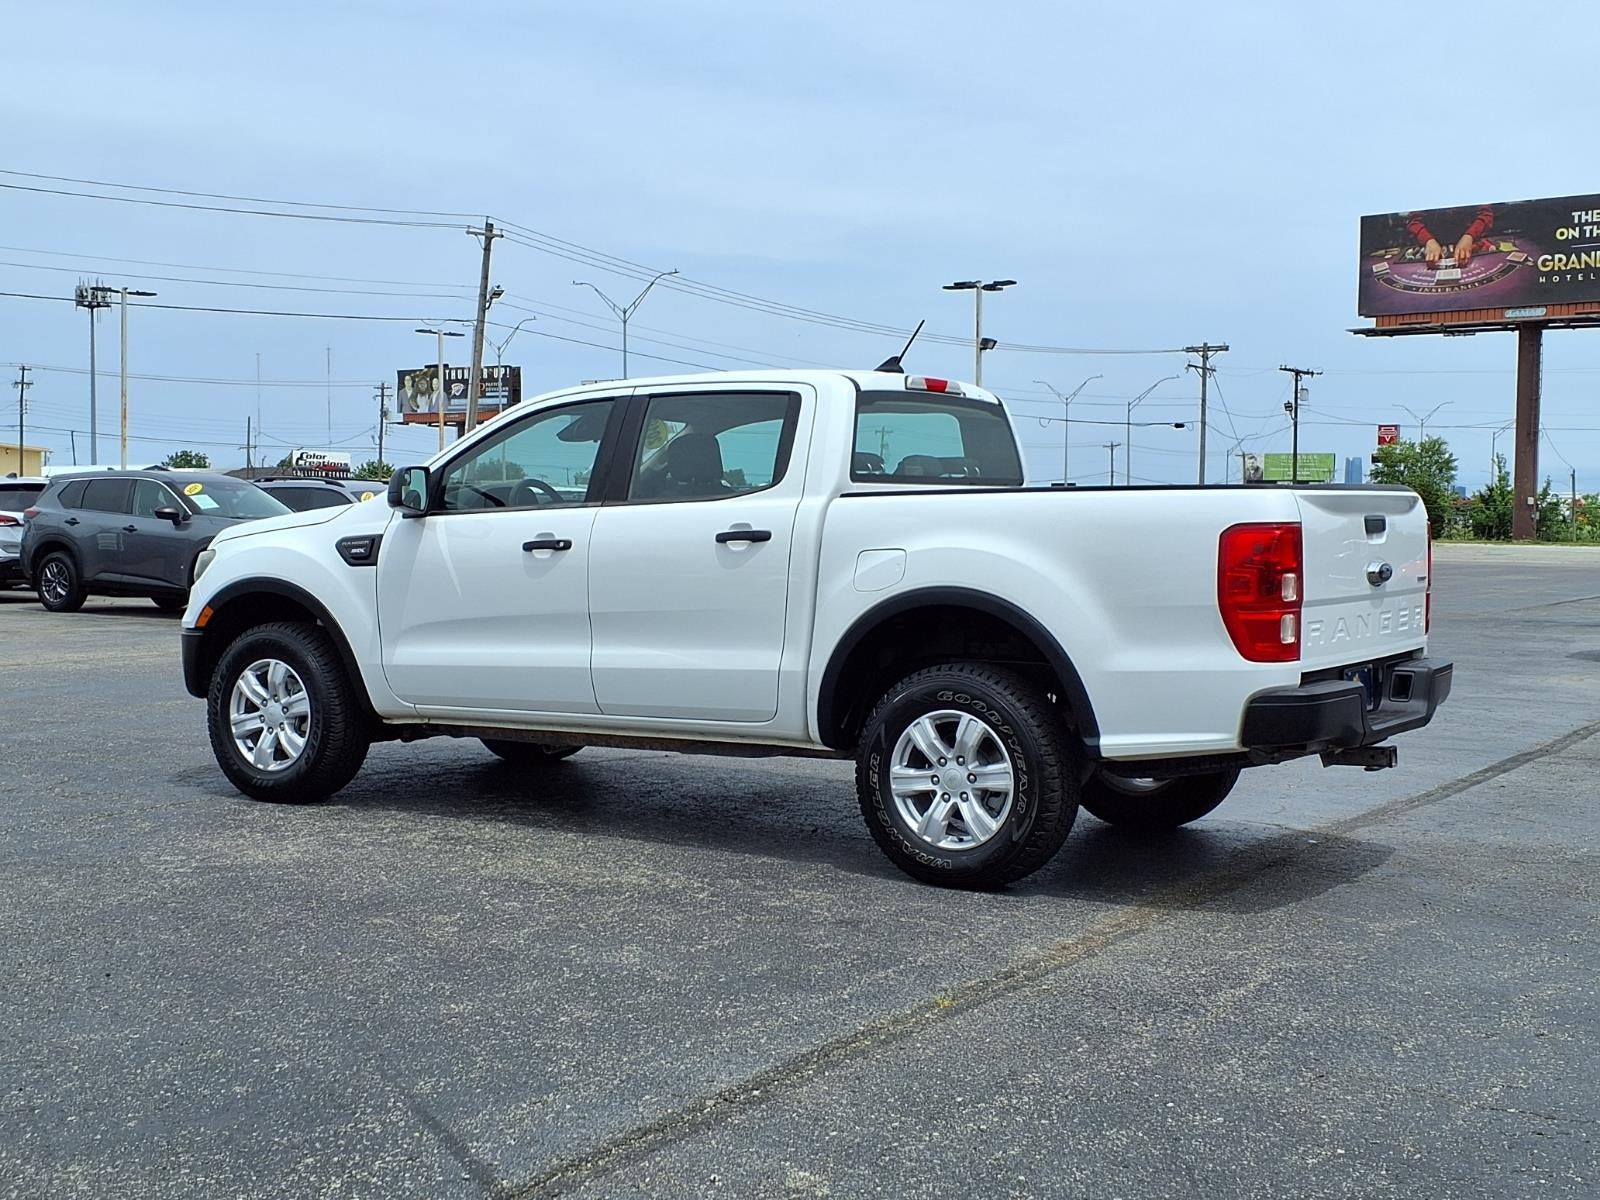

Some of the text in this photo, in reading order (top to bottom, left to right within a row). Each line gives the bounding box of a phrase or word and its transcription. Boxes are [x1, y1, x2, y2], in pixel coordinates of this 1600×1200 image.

[1571, 209, 1600, 224] THE
[1555, 226, 1580, 241] ON
[1539, 273, 1596, 283] HOTEL
[295, 457, 349, 468] Creations
[299, 451, 327, 461] Color
[1305, 604, 1424, 647] RANGER
[936, 690, 1029, 815] GOODYEAR
[868, 753, 954, 871] WRANGLER
